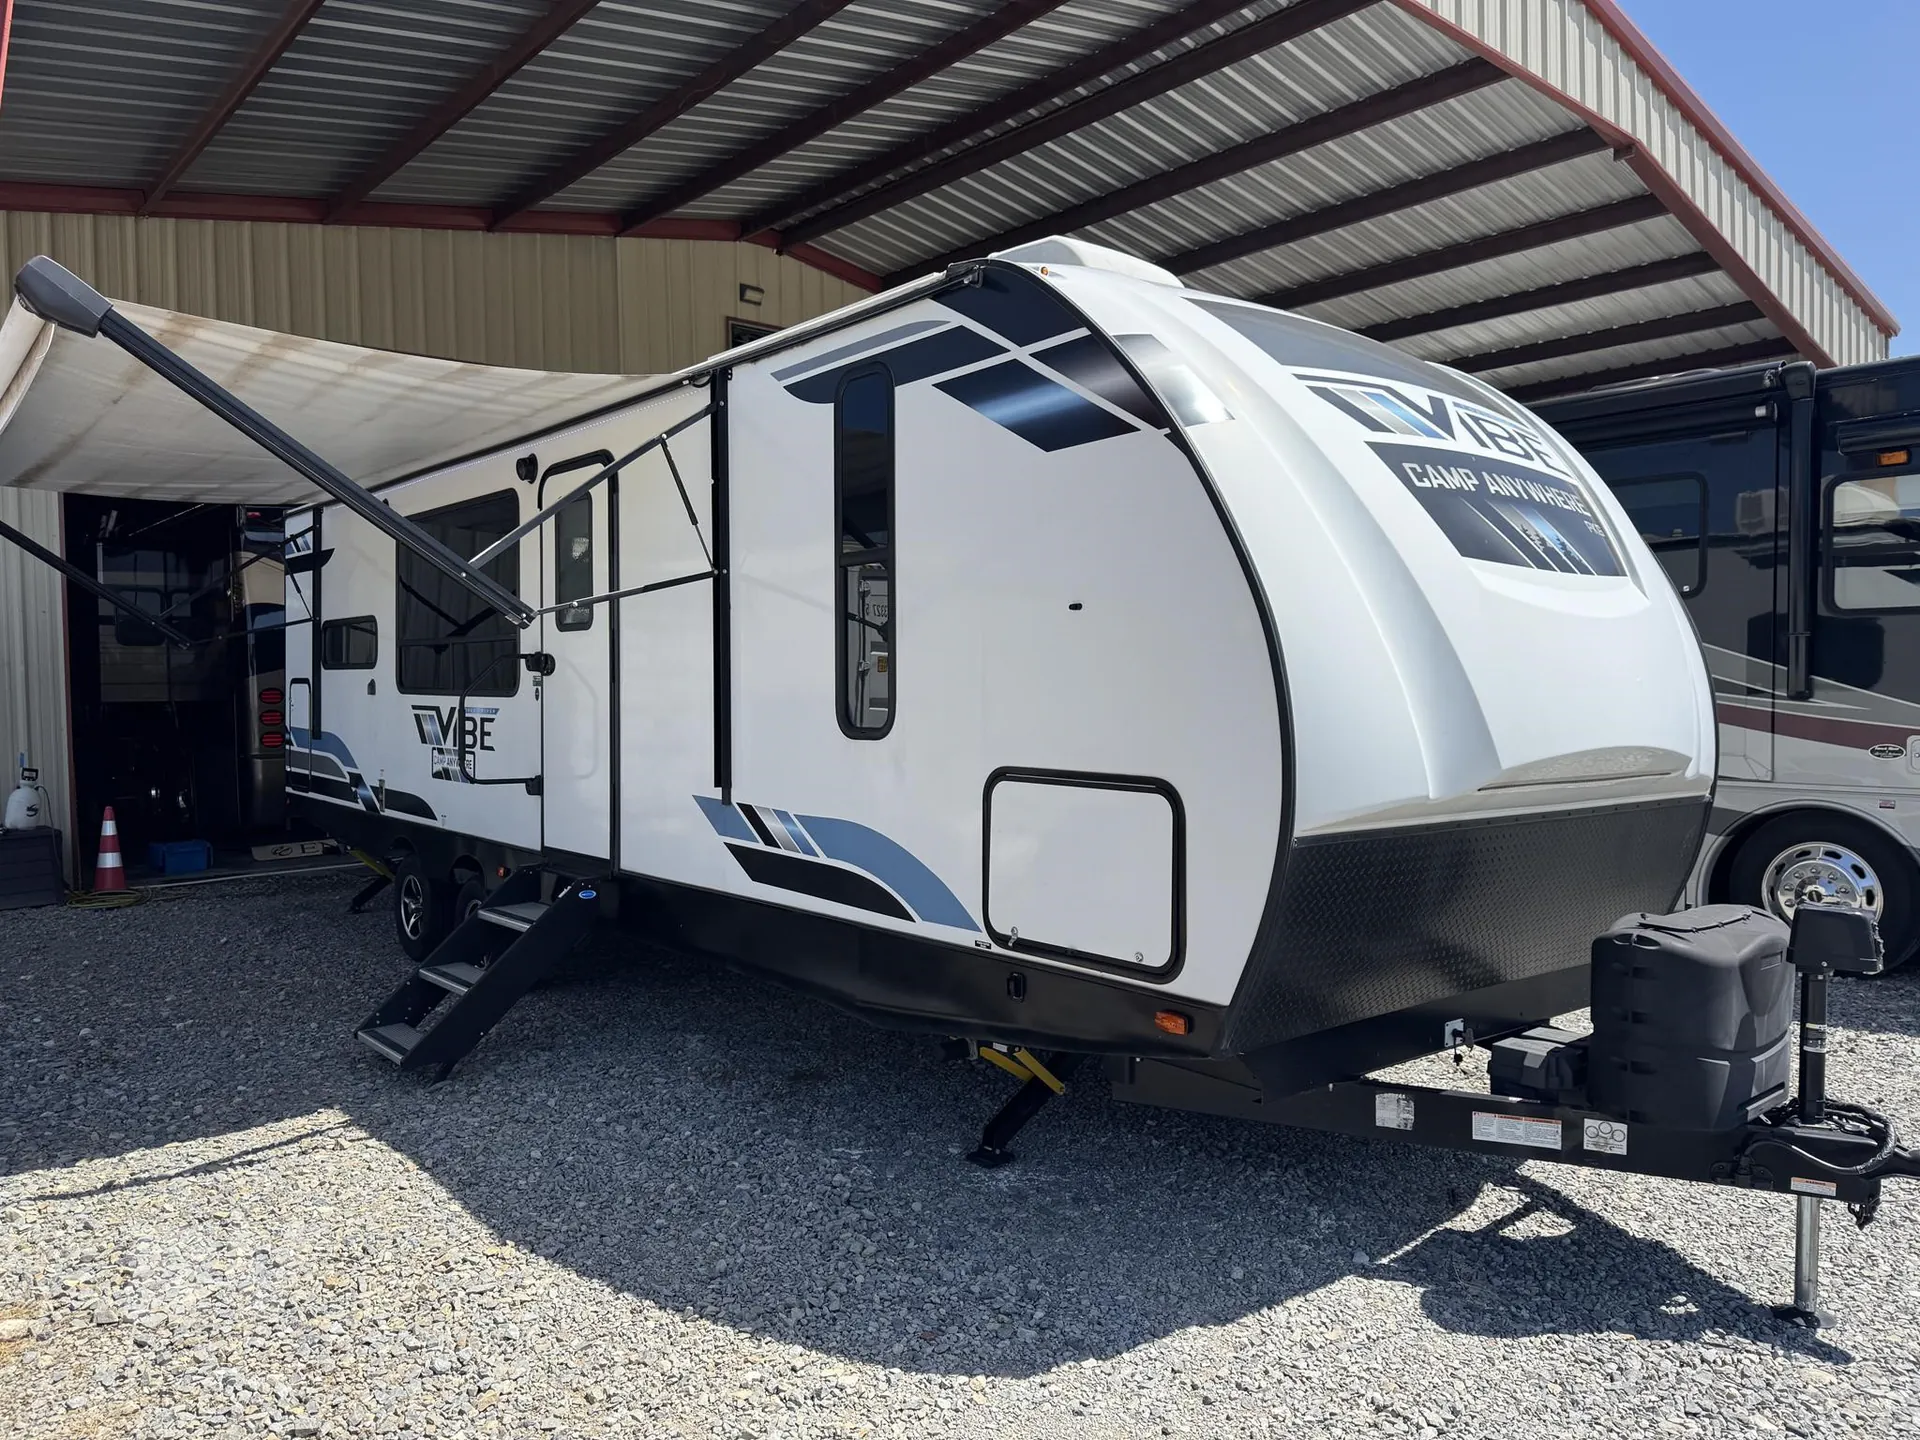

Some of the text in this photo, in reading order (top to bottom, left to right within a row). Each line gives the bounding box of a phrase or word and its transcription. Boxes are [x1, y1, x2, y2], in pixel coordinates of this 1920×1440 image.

[1292, 374, 1574, 479] VIBE
[1402, 462, 1592, 517] CAMP ANYWHERE
[411, 704, 496, 751] VIBE
